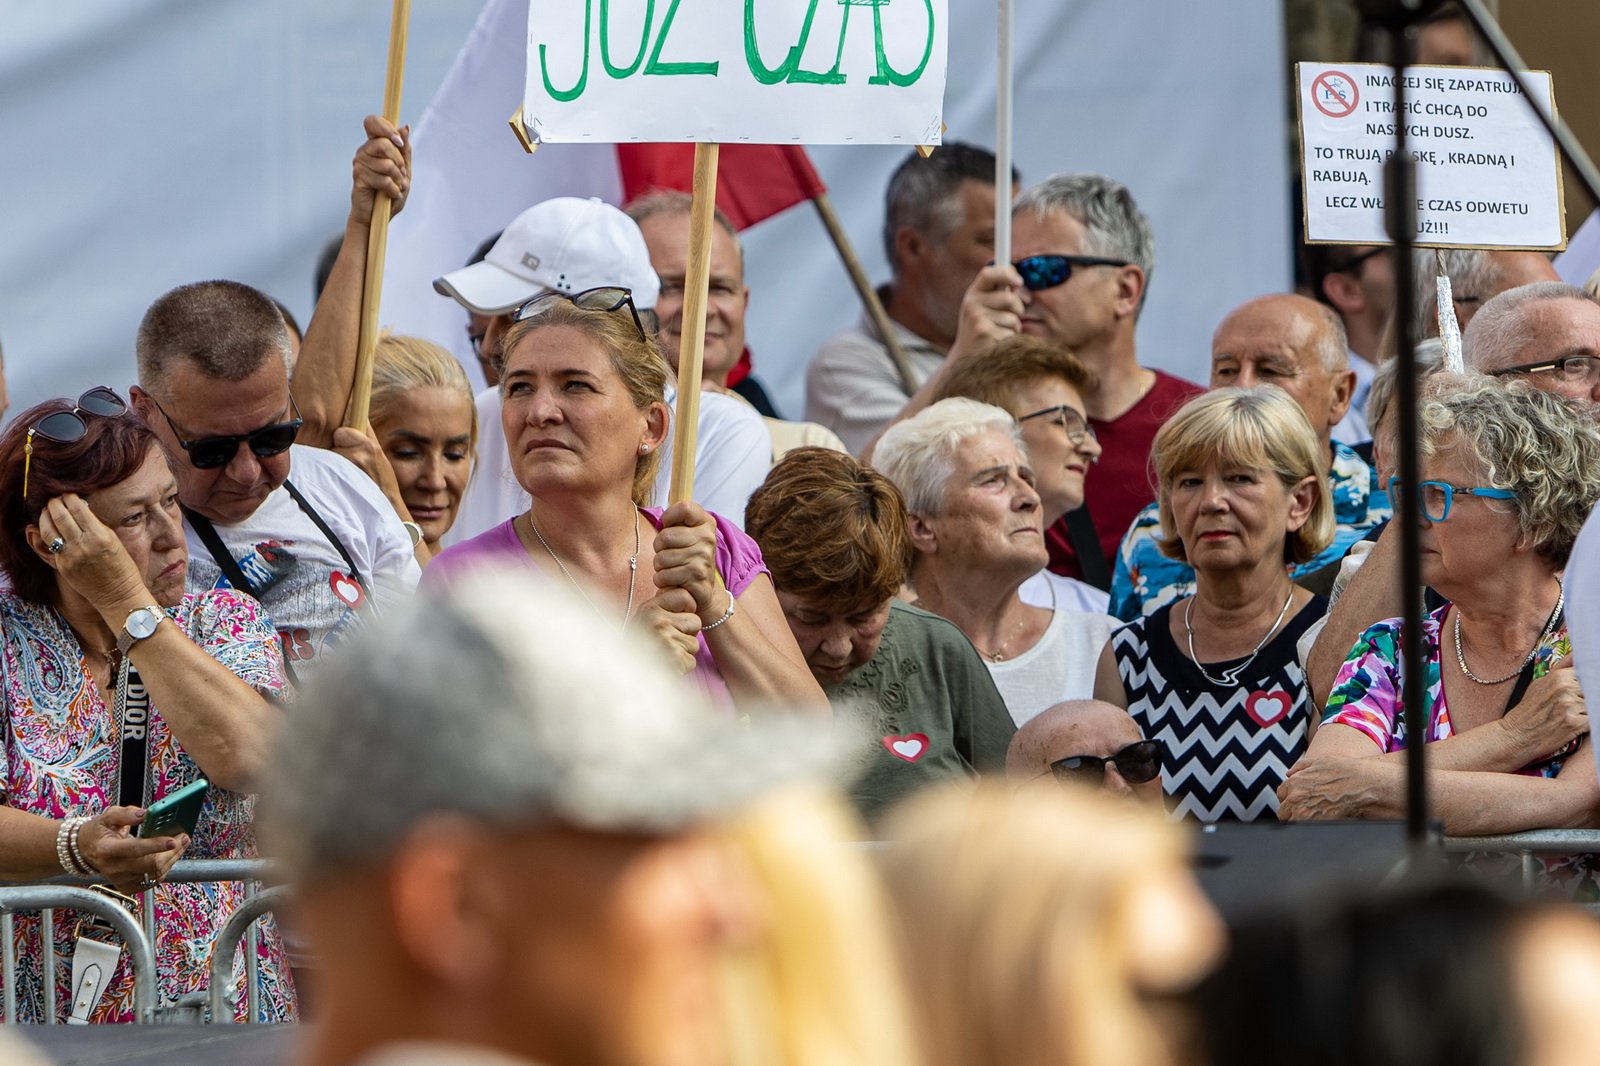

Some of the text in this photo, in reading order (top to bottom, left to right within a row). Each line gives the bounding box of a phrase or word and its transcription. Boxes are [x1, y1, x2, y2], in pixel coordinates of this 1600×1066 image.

[1425, 78, 1444, 93] SIĘ
[1366, 101, 1370, 112] I
[1426, 104, 1463, 118] CHCĄ
[1467, 106, 1488, 117] DO
[1433, 126, 1474, 140] DUSZ.
[1315, 147, 1333, 159] TO
[1337, 148, 1381, 163] TRUJĄ
[1385, 149, 1437, 165] PSKĘ
[1448, 152, 1507, 169] KRADNĄ
[1511, 155, 1515, 166] I
[1313, 170, 1371, 185] RABUJĄ.
[1326, 196, 1357, 208] LECZ
[1428, 199, 1462, 212] CZAS
[1466, 201, 1529, 215] ODWETU
[124, 684, 148, 740] DIOR
